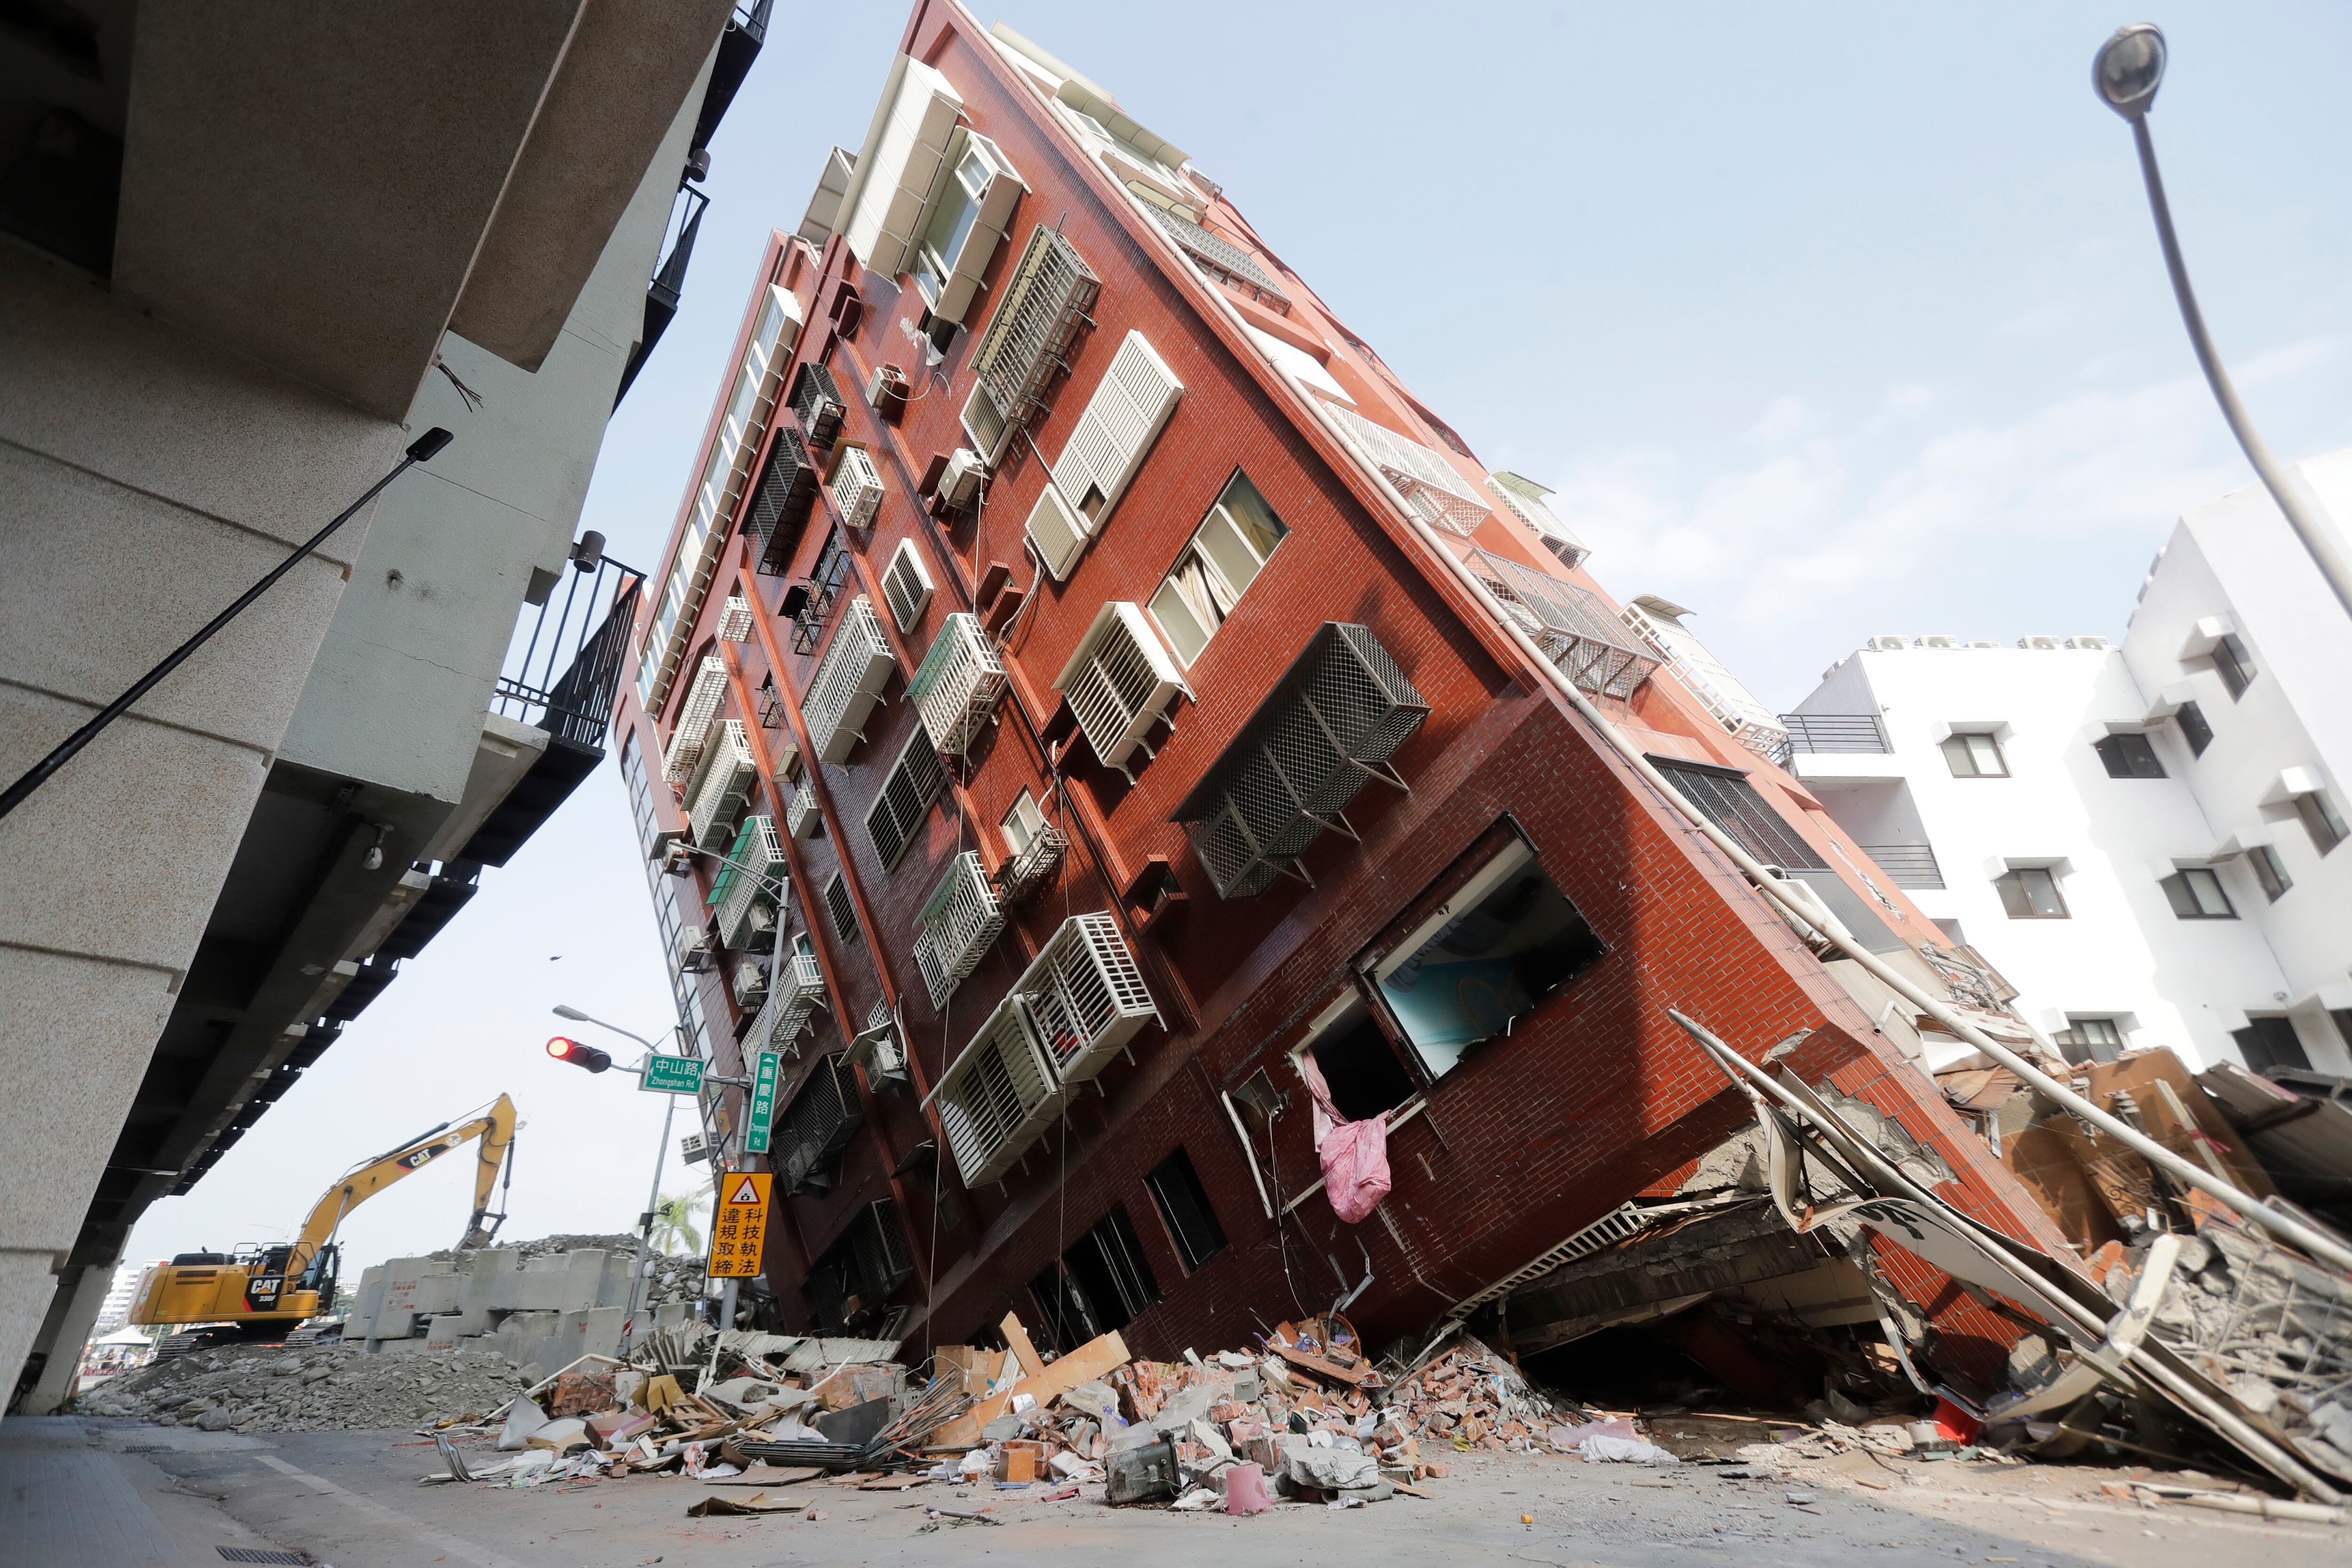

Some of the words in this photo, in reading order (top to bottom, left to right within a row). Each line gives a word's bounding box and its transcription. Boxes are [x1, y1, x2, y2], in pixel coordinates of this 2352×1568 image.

[655, 1059, 699, 1076] 中山路
[651, 1076, 684, 1088] Zhongshan
[685, 1080, 695, 1089] Rd.
[755, 1066, 774, 1115] 重慶路
[409, 1148, 431, 1166] CAT
[713, 1208, 741, 1274] 違規取締
[737, 1208, 763, 1274] 科技執法
[251, 1279, 281, 1294] CAT
